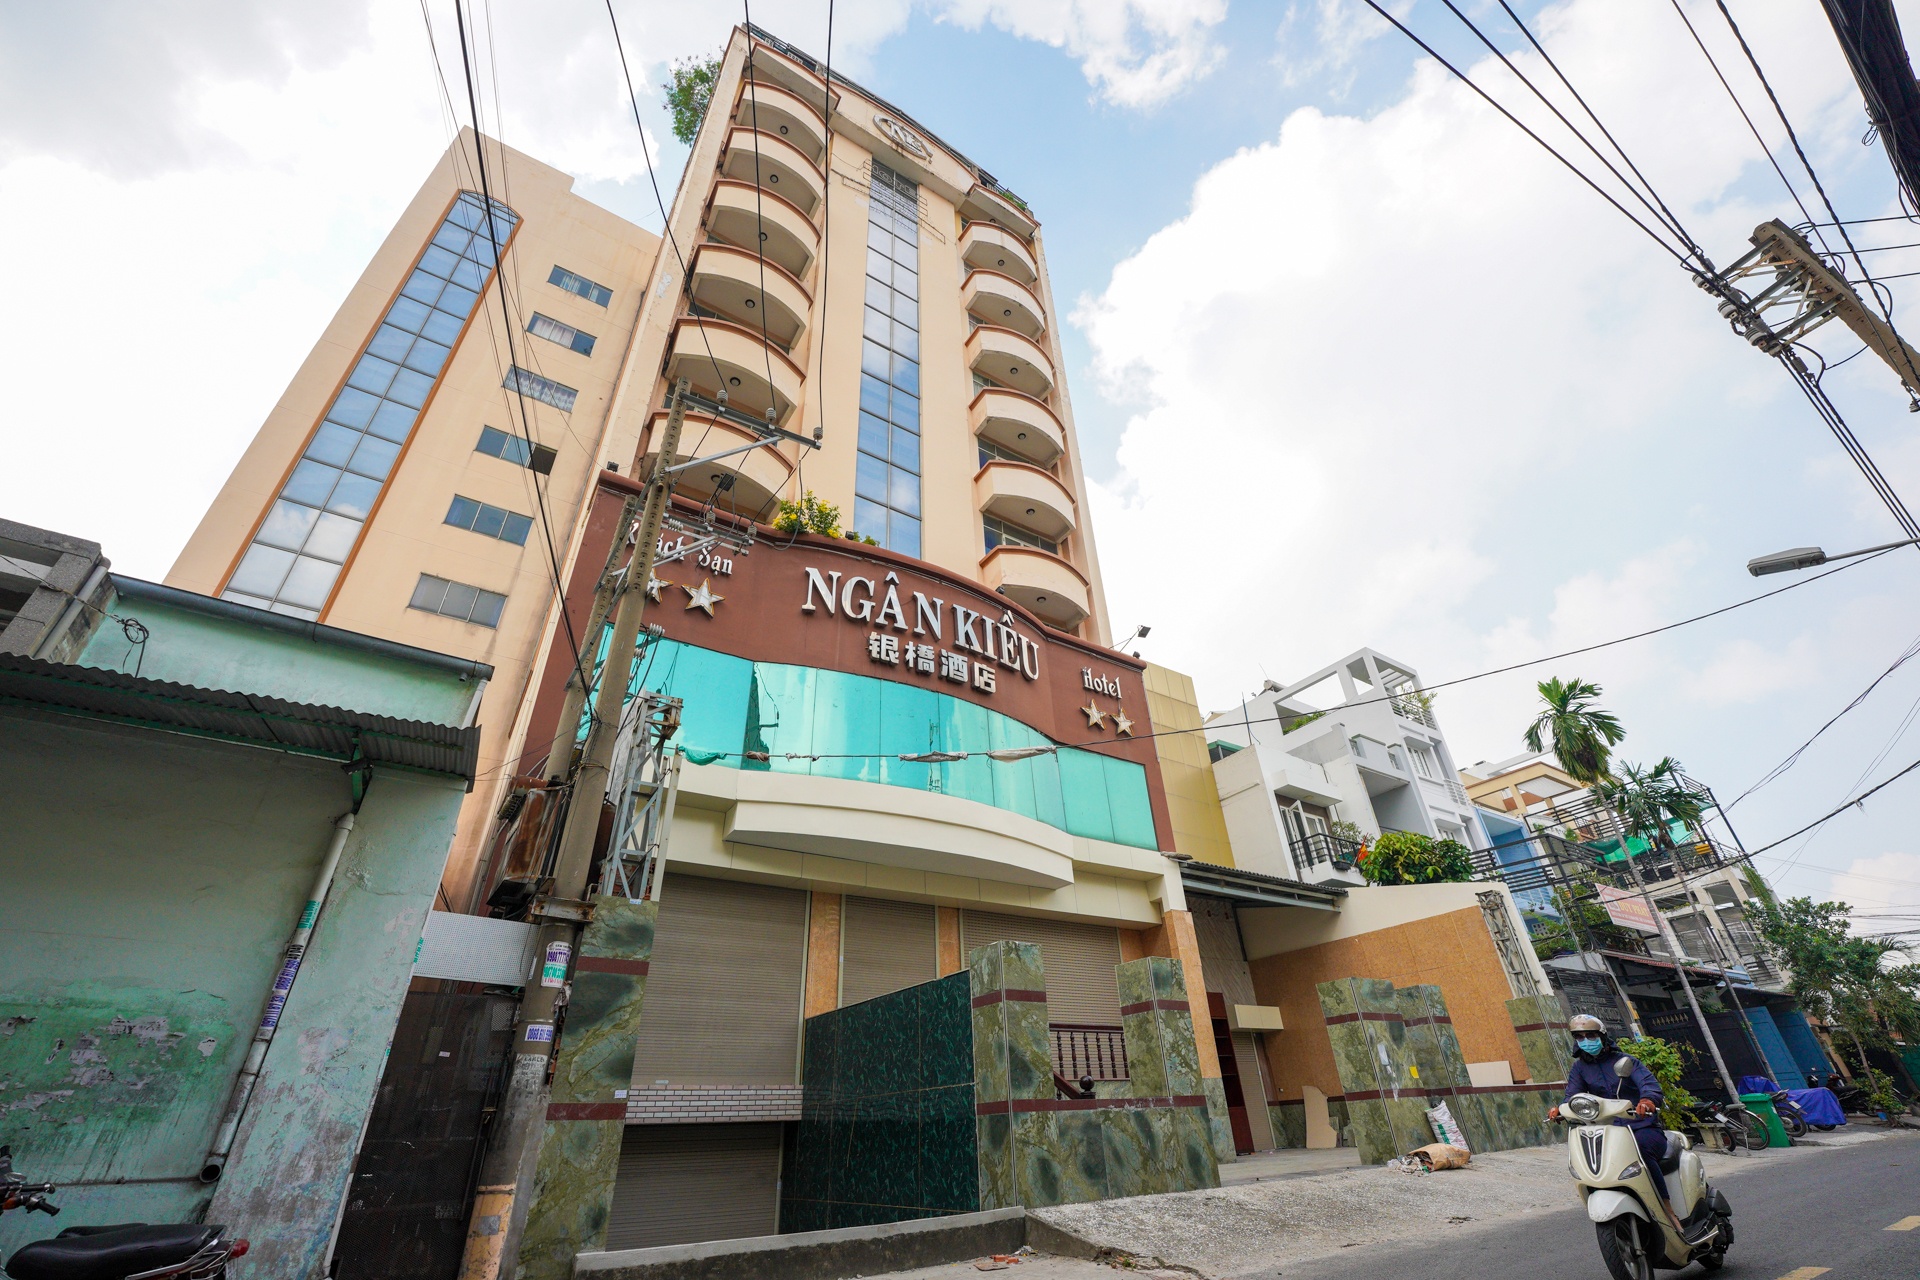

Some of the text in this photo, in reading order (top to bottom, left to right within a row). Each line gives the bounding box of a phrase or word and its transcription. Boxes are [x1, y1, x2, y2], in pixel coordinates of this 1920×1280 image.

[699, 543, 732, 575] Sạn
[802, 567, 943, 641] NGÂN
[1082, 667, 1122, 699] Hotel
